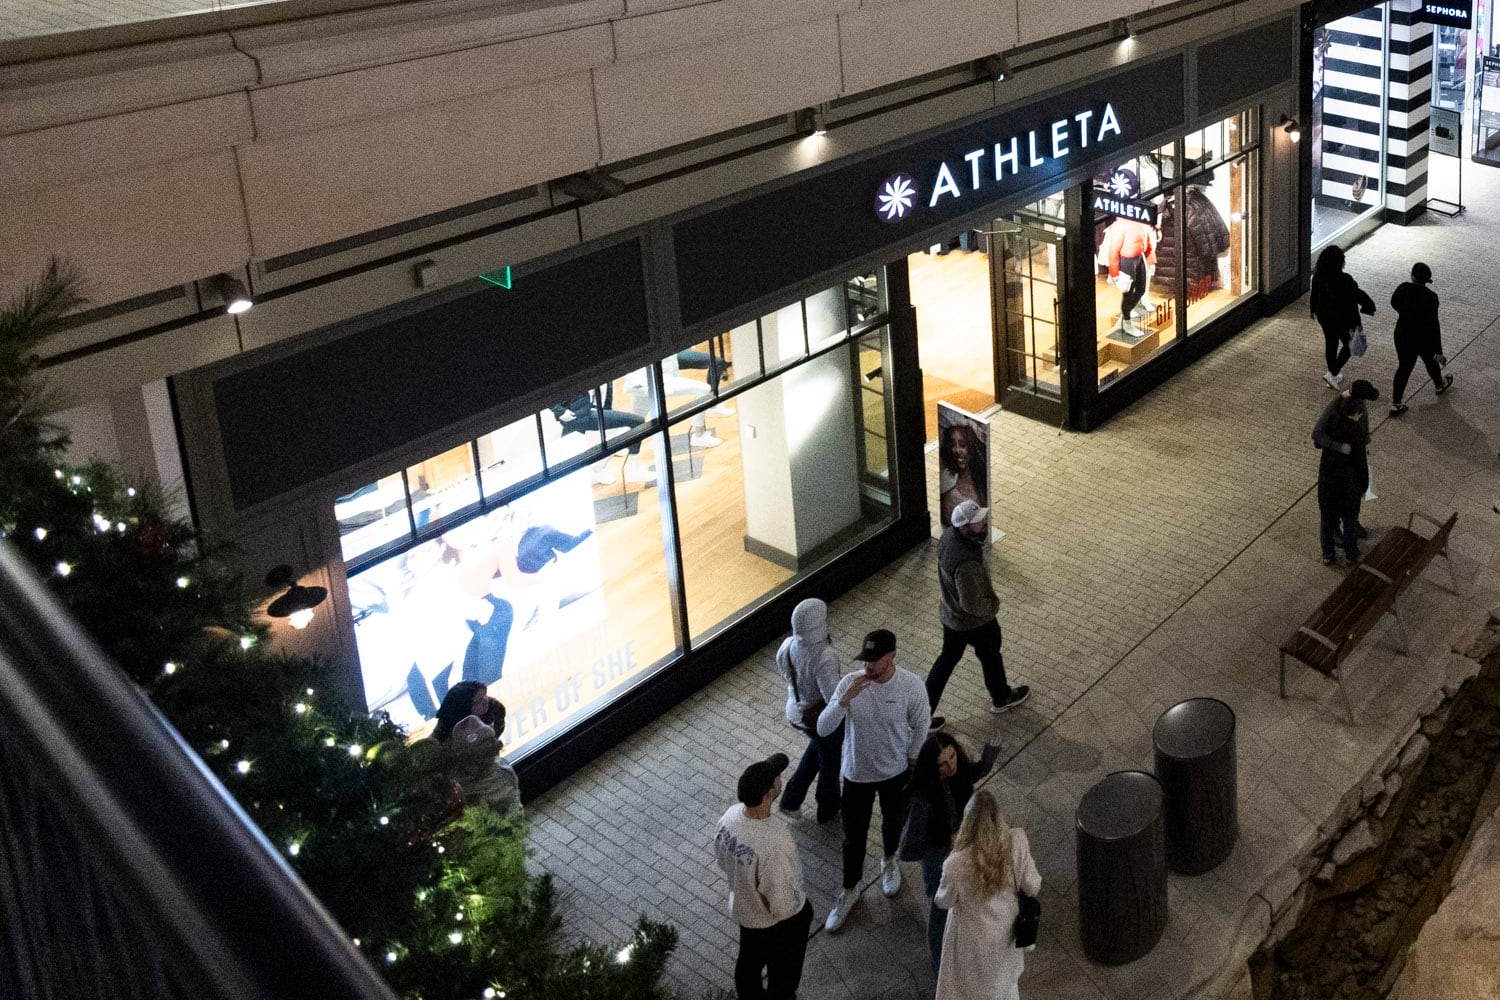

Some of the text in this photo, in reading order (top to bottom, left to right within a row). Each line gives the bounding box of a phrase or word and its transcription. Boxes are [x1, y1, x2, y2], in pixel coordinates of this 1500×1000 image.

[1425, 4, 1467, 18] SEPHORA
[929, 102, 1122, 198] ATHLETA
[1094, 196, 1151, 222] ATHLETA
[591, 640, 638, 690] SHE
